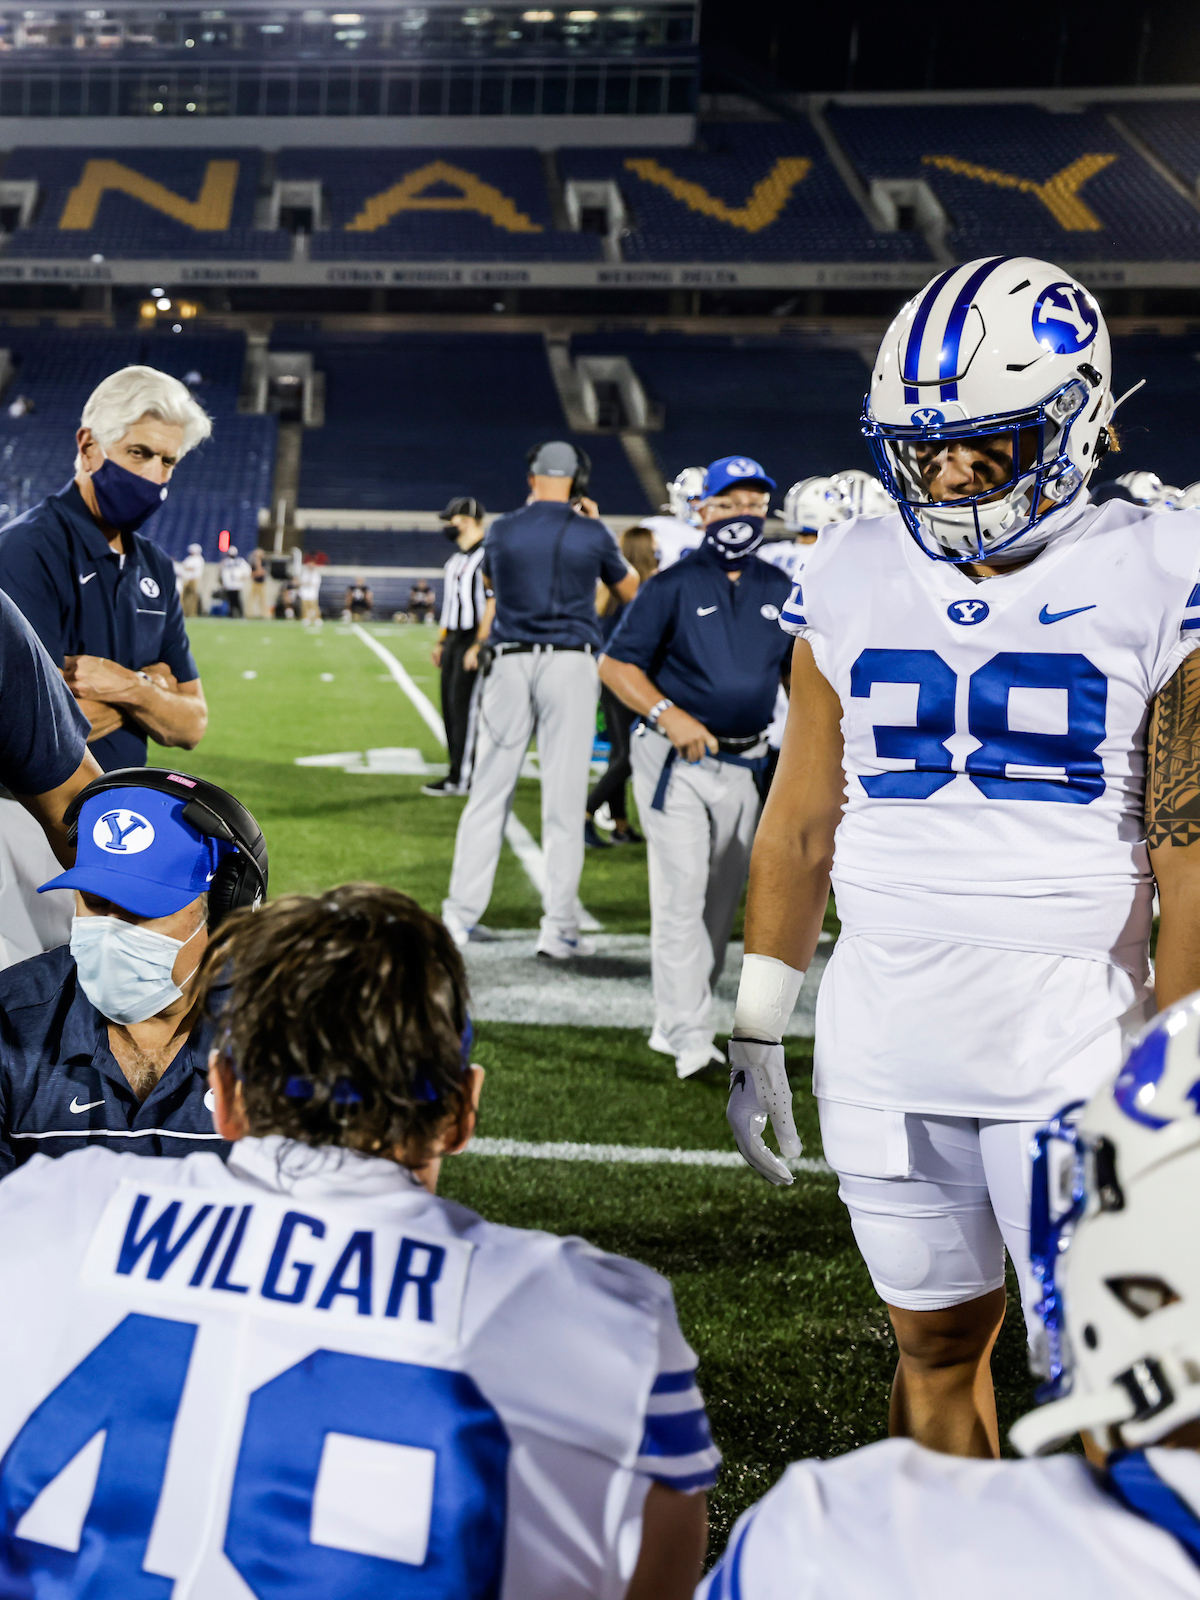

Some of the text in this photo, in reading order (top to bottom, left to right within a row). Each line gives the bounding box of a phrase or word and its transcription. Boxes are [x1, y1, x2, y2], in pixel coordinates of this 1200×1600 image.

[58, 153, 1118, 232] NAVY
[850, 648, 1108, 805] 38
[116, 1194, 446, 1323] WILGAR
